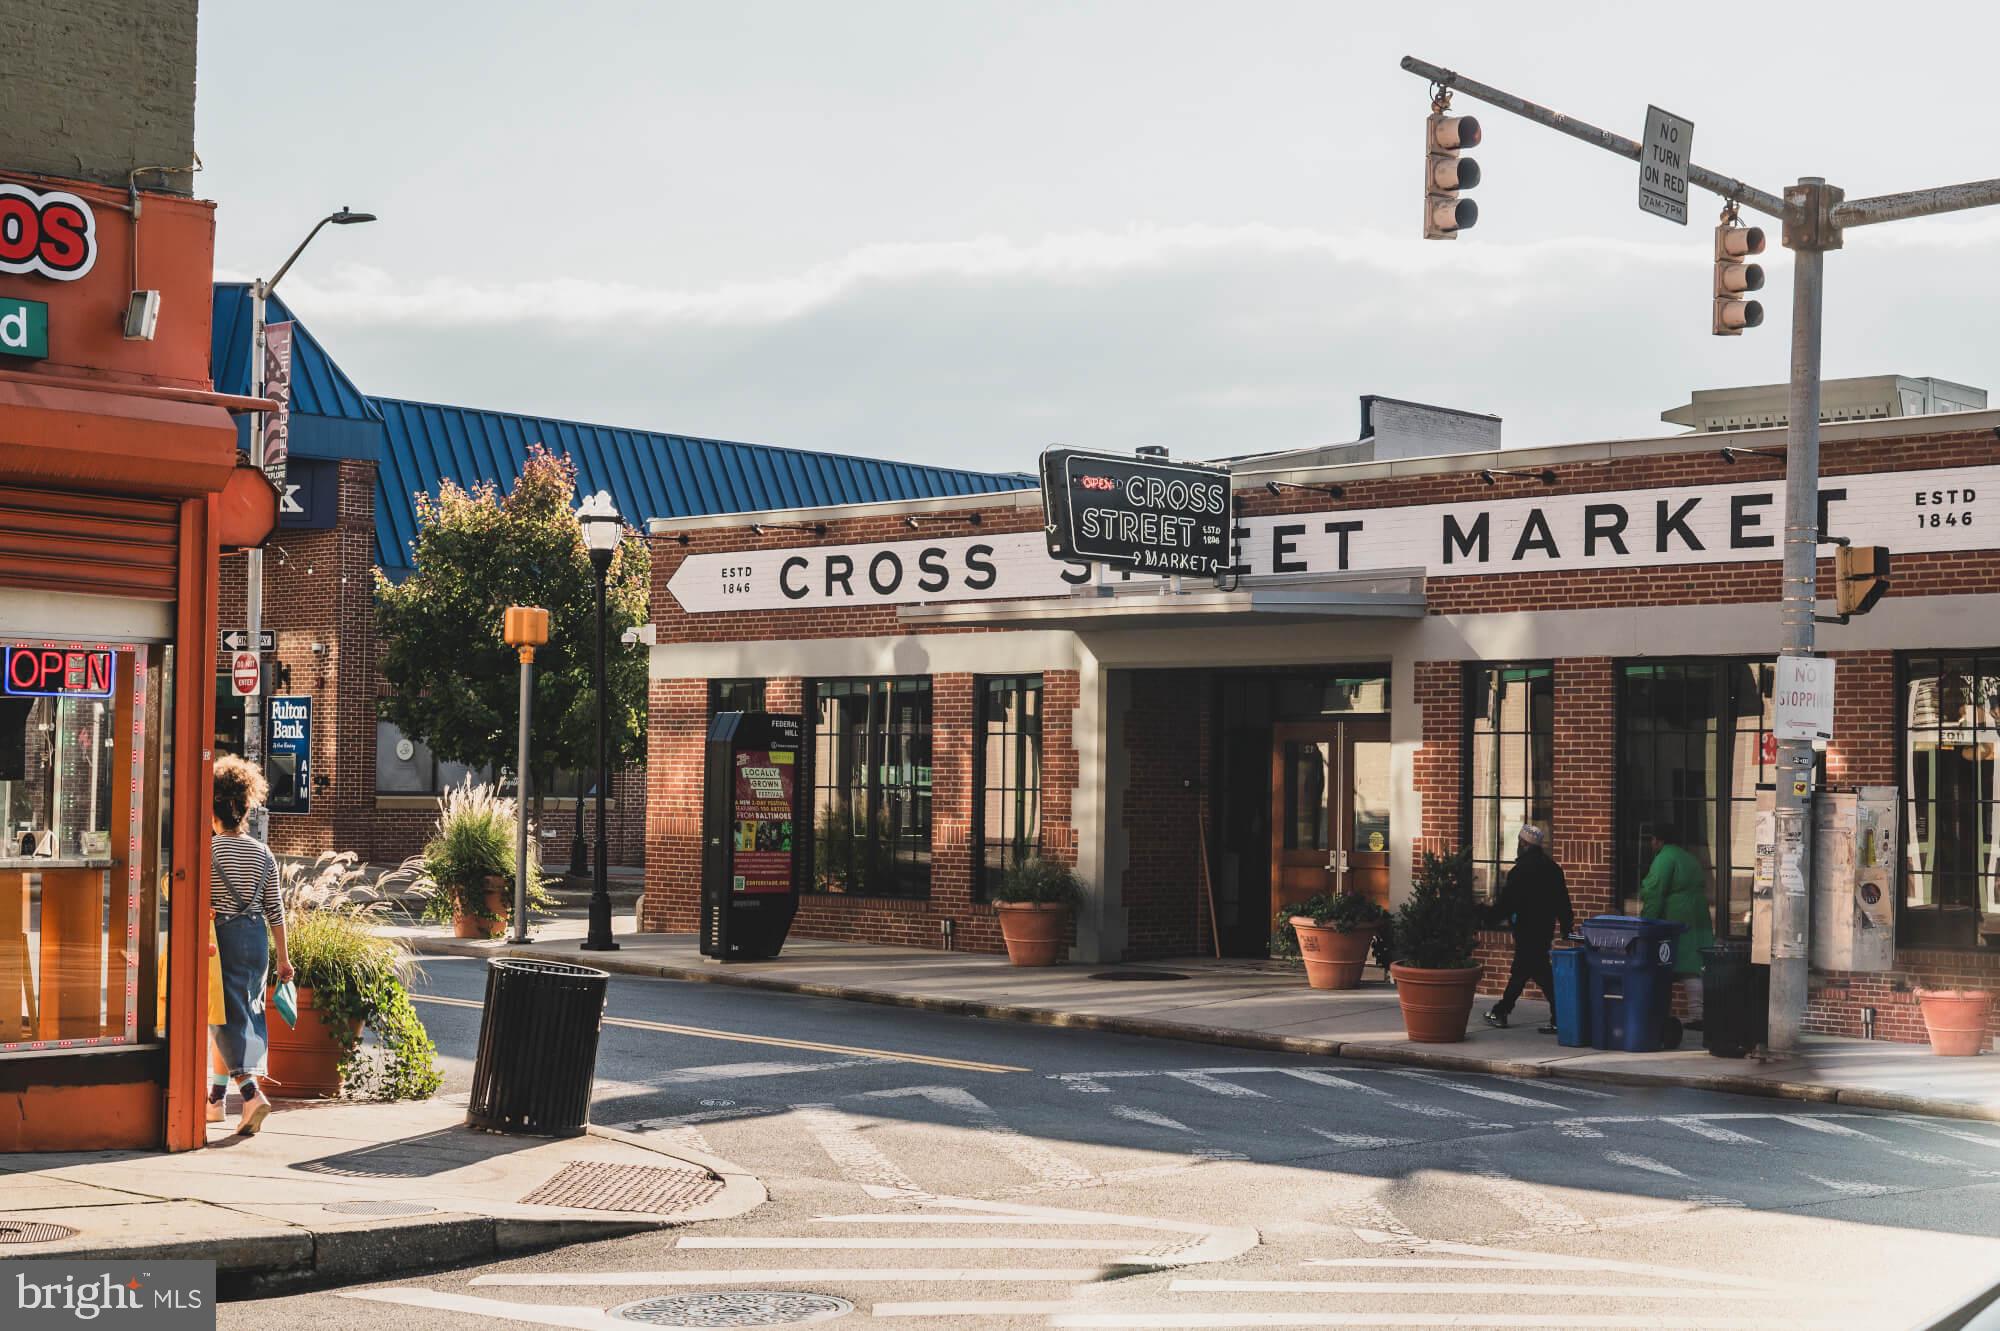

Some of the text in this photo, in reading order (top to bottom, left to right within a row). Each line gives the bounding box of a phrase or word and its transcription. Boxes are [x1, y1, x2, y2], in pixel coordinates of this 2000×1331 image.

[1660, 122, 1678, 144] NO
[1653, 144, 1680, 169] TURN
[1644, 165, 1685, 194] ON RED
[1642, 194, 1683, 217] 7AM-7PM
[280, 335, 291, 373] HILL
[1126, 475, 1224, 514] CROSS
[1915, 488, 1977, 506] ESTD
[1081, 507, 1196, 547] STREET
[1917, 511, 1973, 529] 1846
[1144, 549, 1208, 572] MARKET
[721, 566, 753, 579] ESTD
[779, 544, 997, 600] CROSS
[722, 582, 751, 594] 1846
[10, 650, 110, 690] OPEN
[1794, 667, 1817, 683] NO
[271, 701, 308, 720] Fulton
[272, 720, 305, 739] Bank
[771, 719, 799, 729] FEDERAL
[784, 729, 799, 737] HILL
[300, 759, 308, 799] ATM
[744, 768, 778, 777] LOCALLY
[751, 780, 780, 789] GROWN
[755, 812, 792, 820] BALTIMORE
